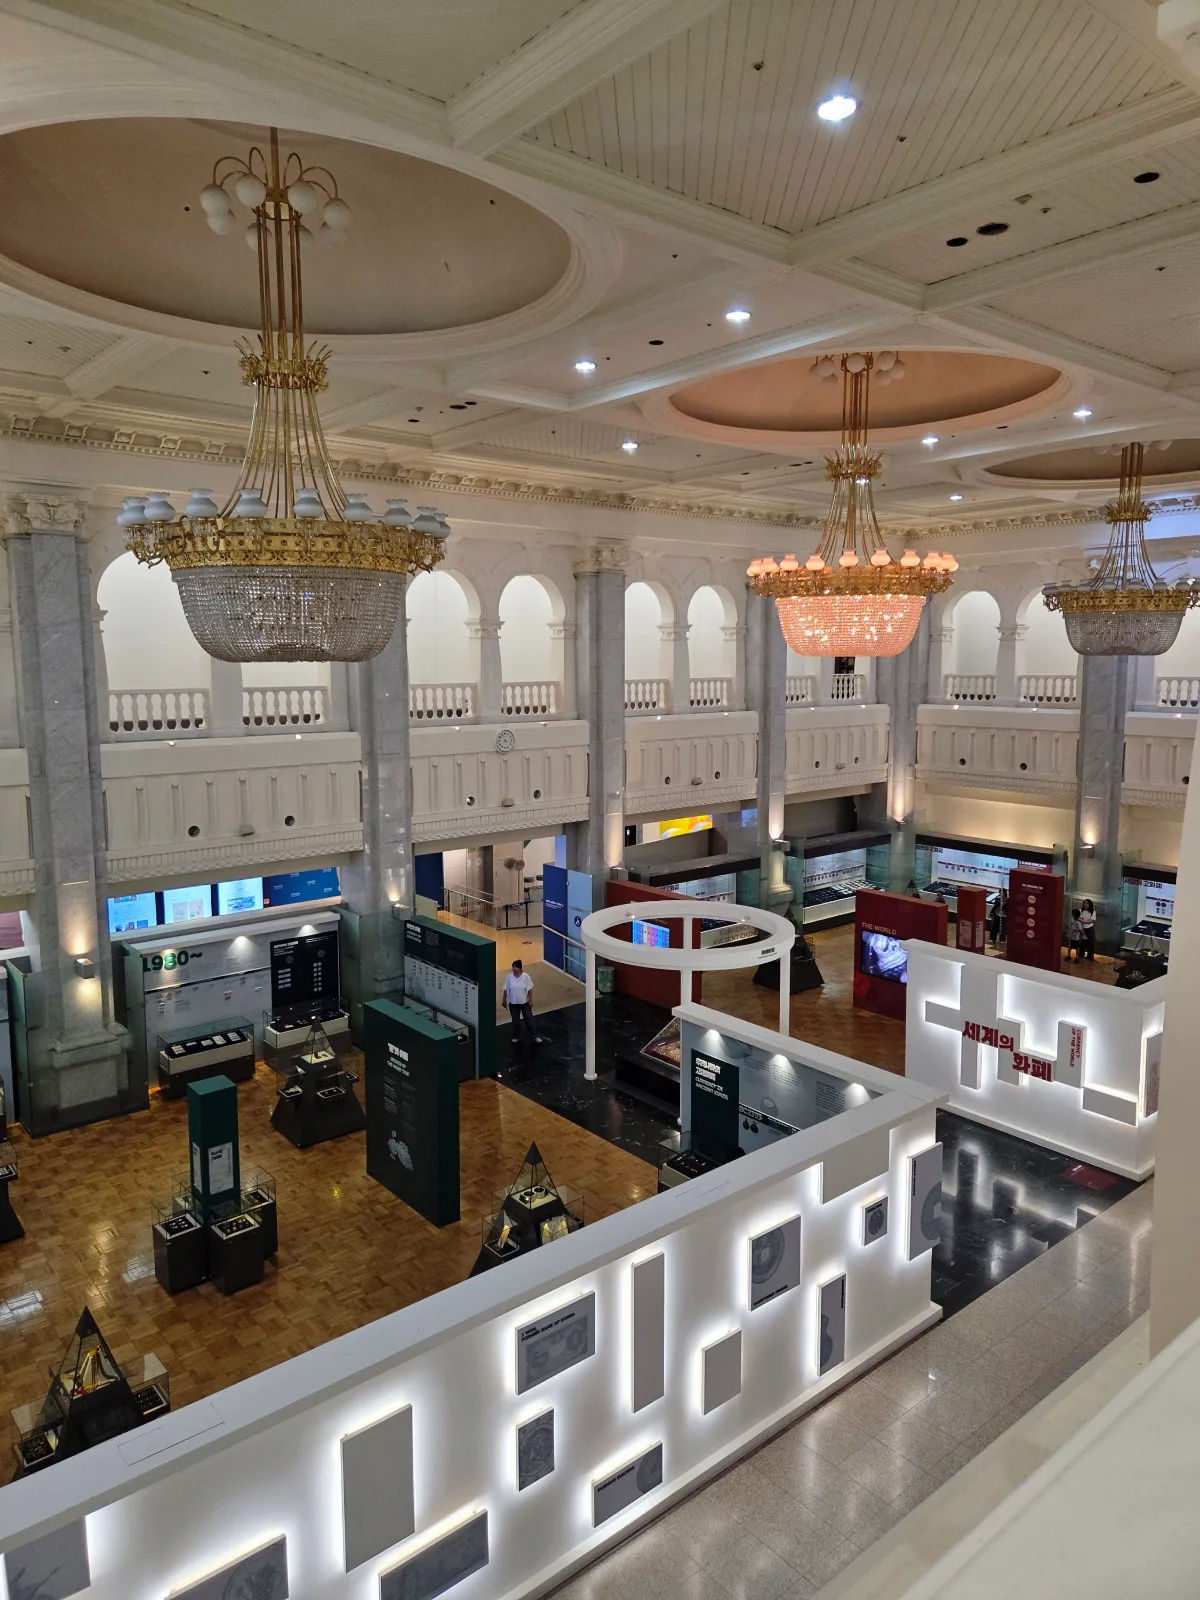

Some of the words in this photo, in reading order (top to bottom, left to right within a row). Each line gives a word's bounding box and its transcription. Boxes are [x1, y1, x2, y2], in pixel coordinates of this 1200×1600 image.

[874, 925, 897, 935] WORLD
[962, 1020, 1014, 1052] 세계의
[1012, 1052, 1052, 1082] 화폐
